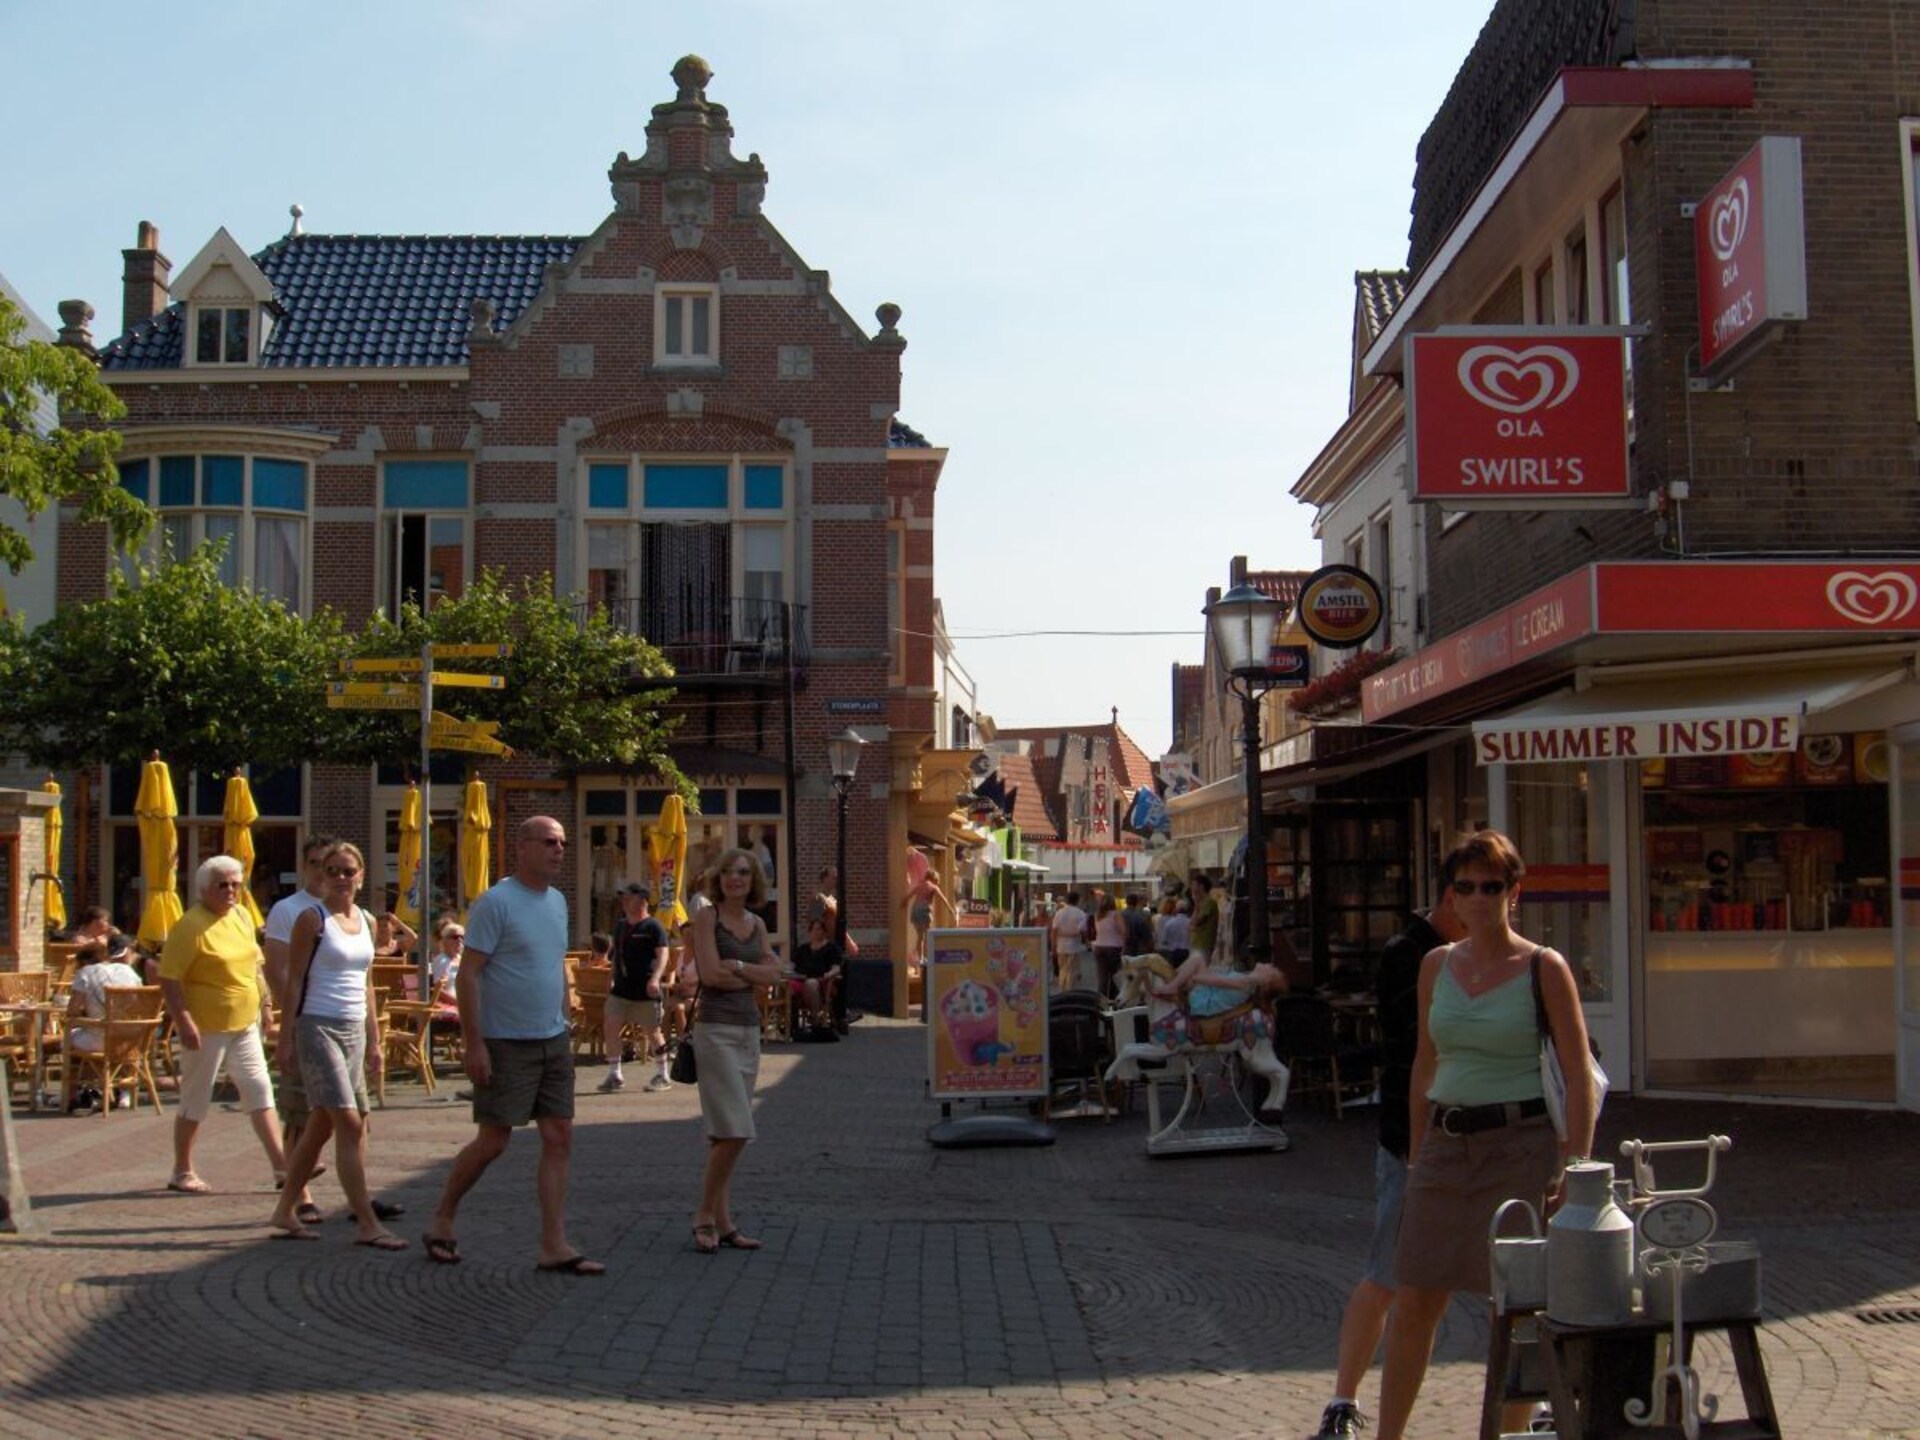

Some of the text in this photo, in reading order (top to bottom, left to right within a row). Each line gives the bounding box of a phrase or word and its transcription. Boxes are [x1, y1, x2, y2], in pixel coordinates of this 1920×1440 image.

[1722, 268, 1738, 287] OLA
[1712, 290, 1754, 348] SWIRL'S
[1497, 420, 1543, 437] OLA
[1460, 458, 1584, 486] SWIRL'S
[1317, 595, 1365, 607] AMSTEL
[1530, 598, 1564, 641] CREAM
[1481, 717, 1792, 762] SUMMER INSIDE
[1094, 766, 1107, 833] HEMA
